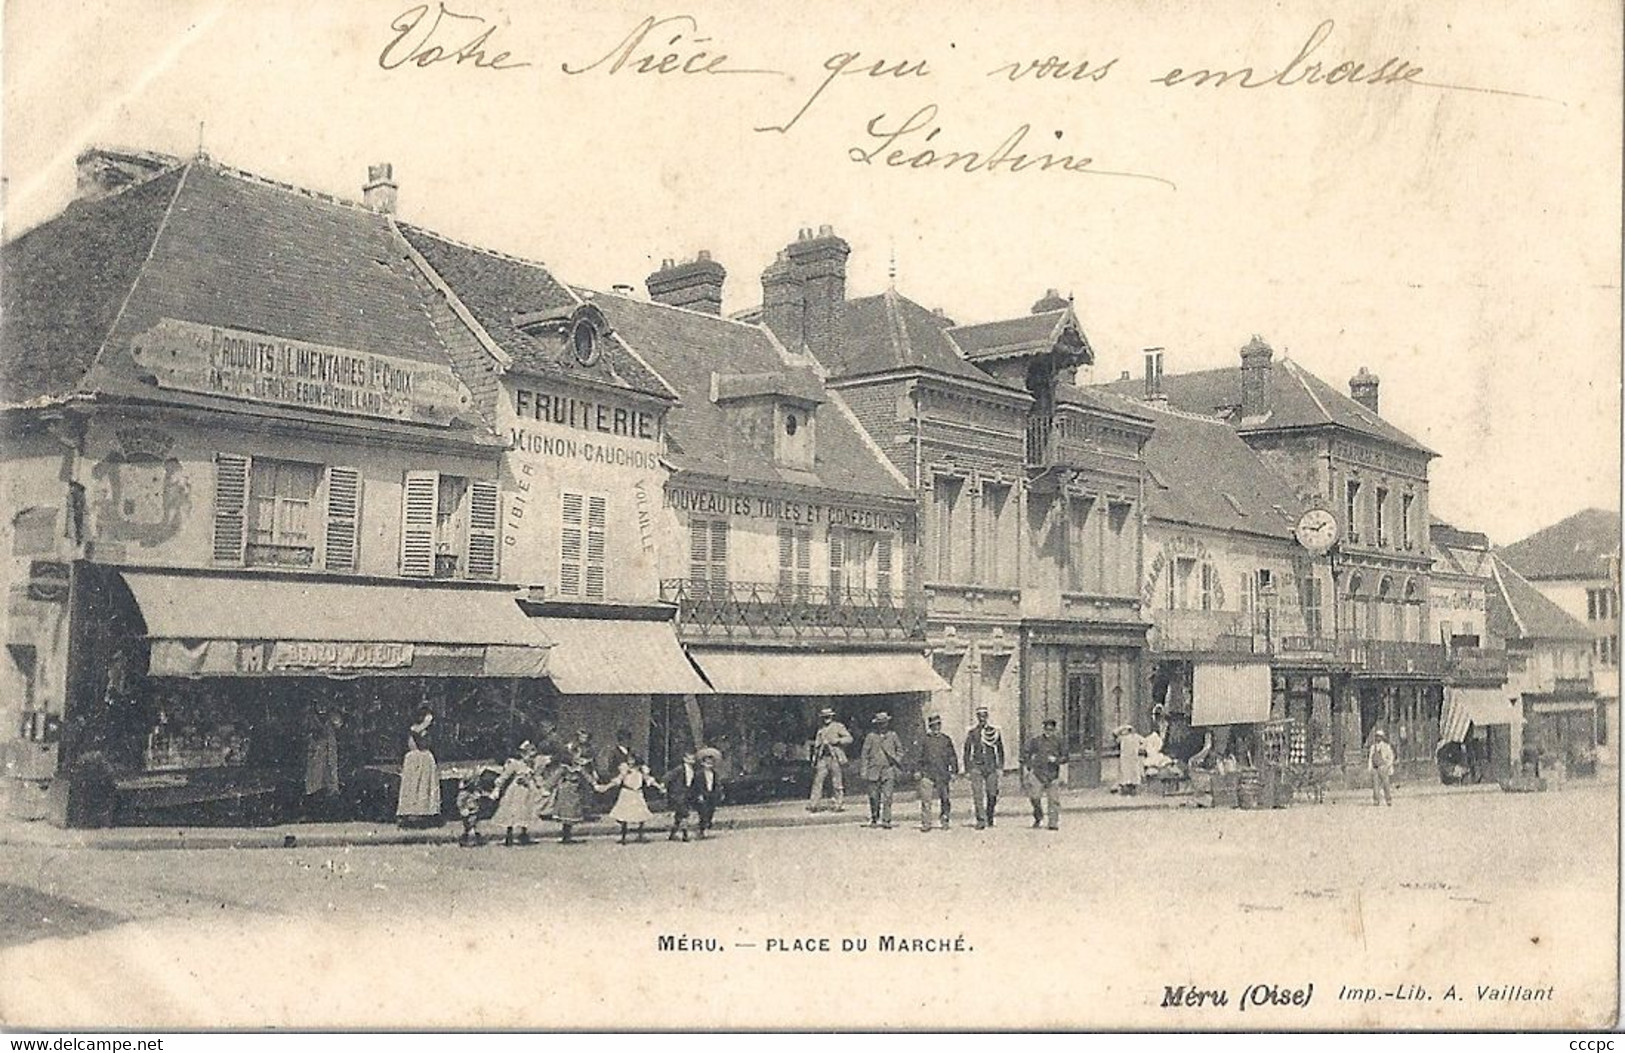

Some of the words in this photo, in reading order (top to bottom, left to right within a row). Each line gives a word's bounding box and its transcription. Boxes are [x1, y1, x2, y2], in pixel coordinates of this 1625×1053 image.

[379, 2, 532, 70] Votre
[754, 42, 956, 132] qui
[986, 55, 1120, 82] vous
[1151, 18, 1530, 100] embrasse
[516, 388, 652, 440] FRUITERIE
[504, 463, 534, 548] GIBIER
[633, 478, 655, 554] VOLAILLE
[758, 499, 801, 521] TOILES
[806, 503, 821, 524] ET
